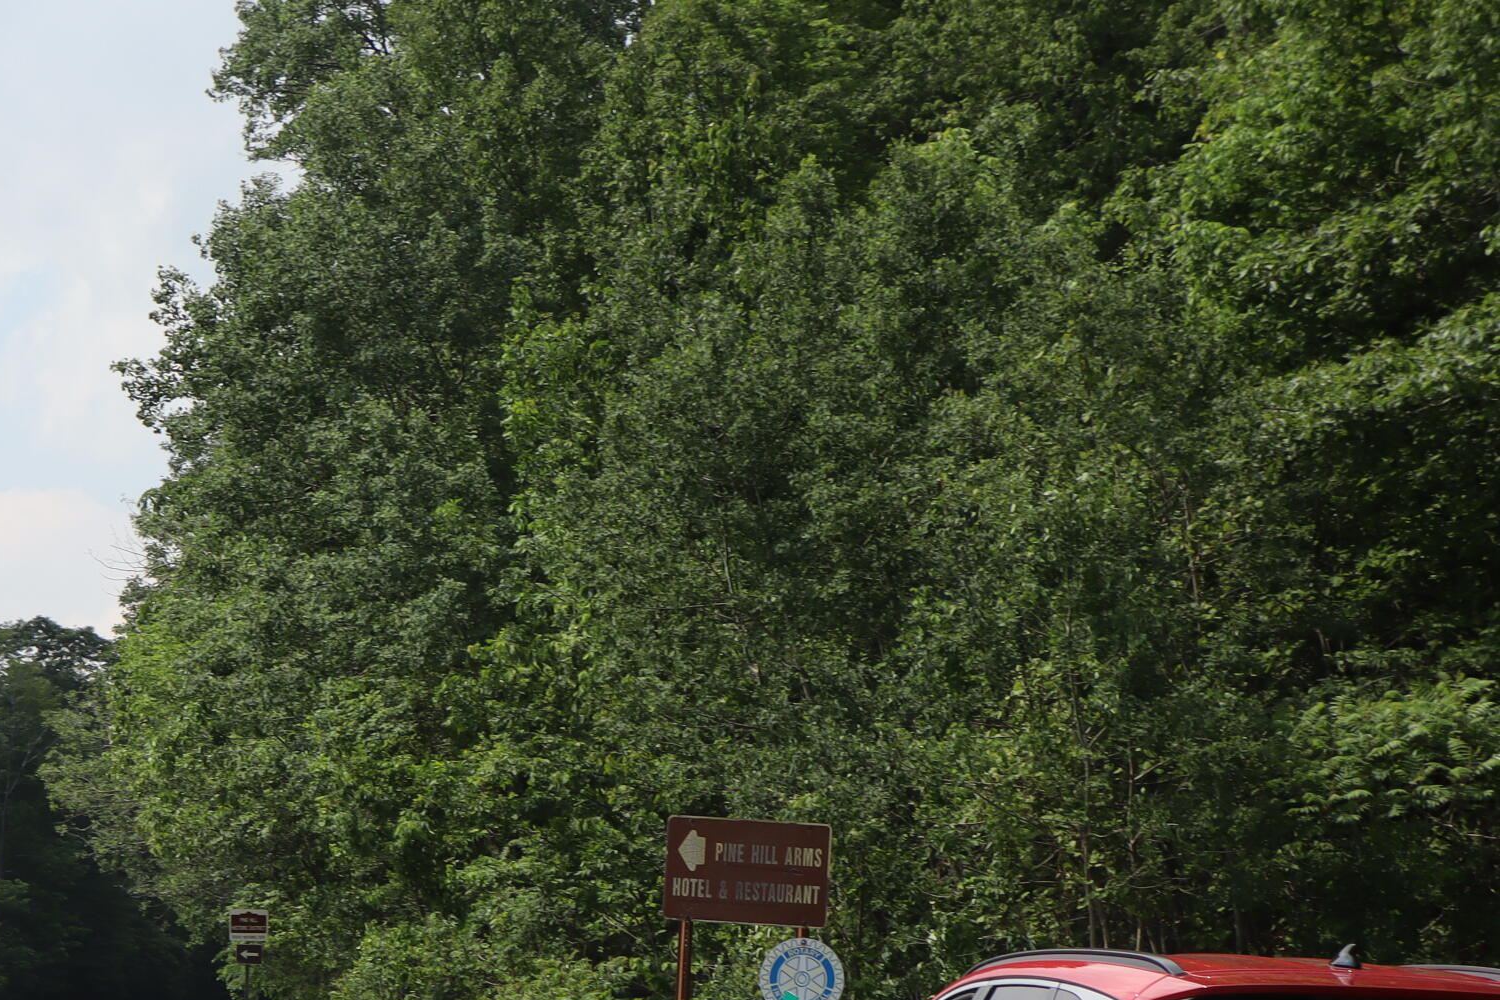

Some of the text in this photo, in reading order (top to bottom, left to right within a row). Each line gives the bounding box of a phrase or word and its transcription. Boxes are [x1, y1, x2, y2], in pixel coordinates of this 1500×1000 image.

[715, 842, 823, 868] PINE HILL ARMS
[672, 877, 821, 905] HOTEL & RESTAURANT
[787, 947, 822, 959] ROTARY
